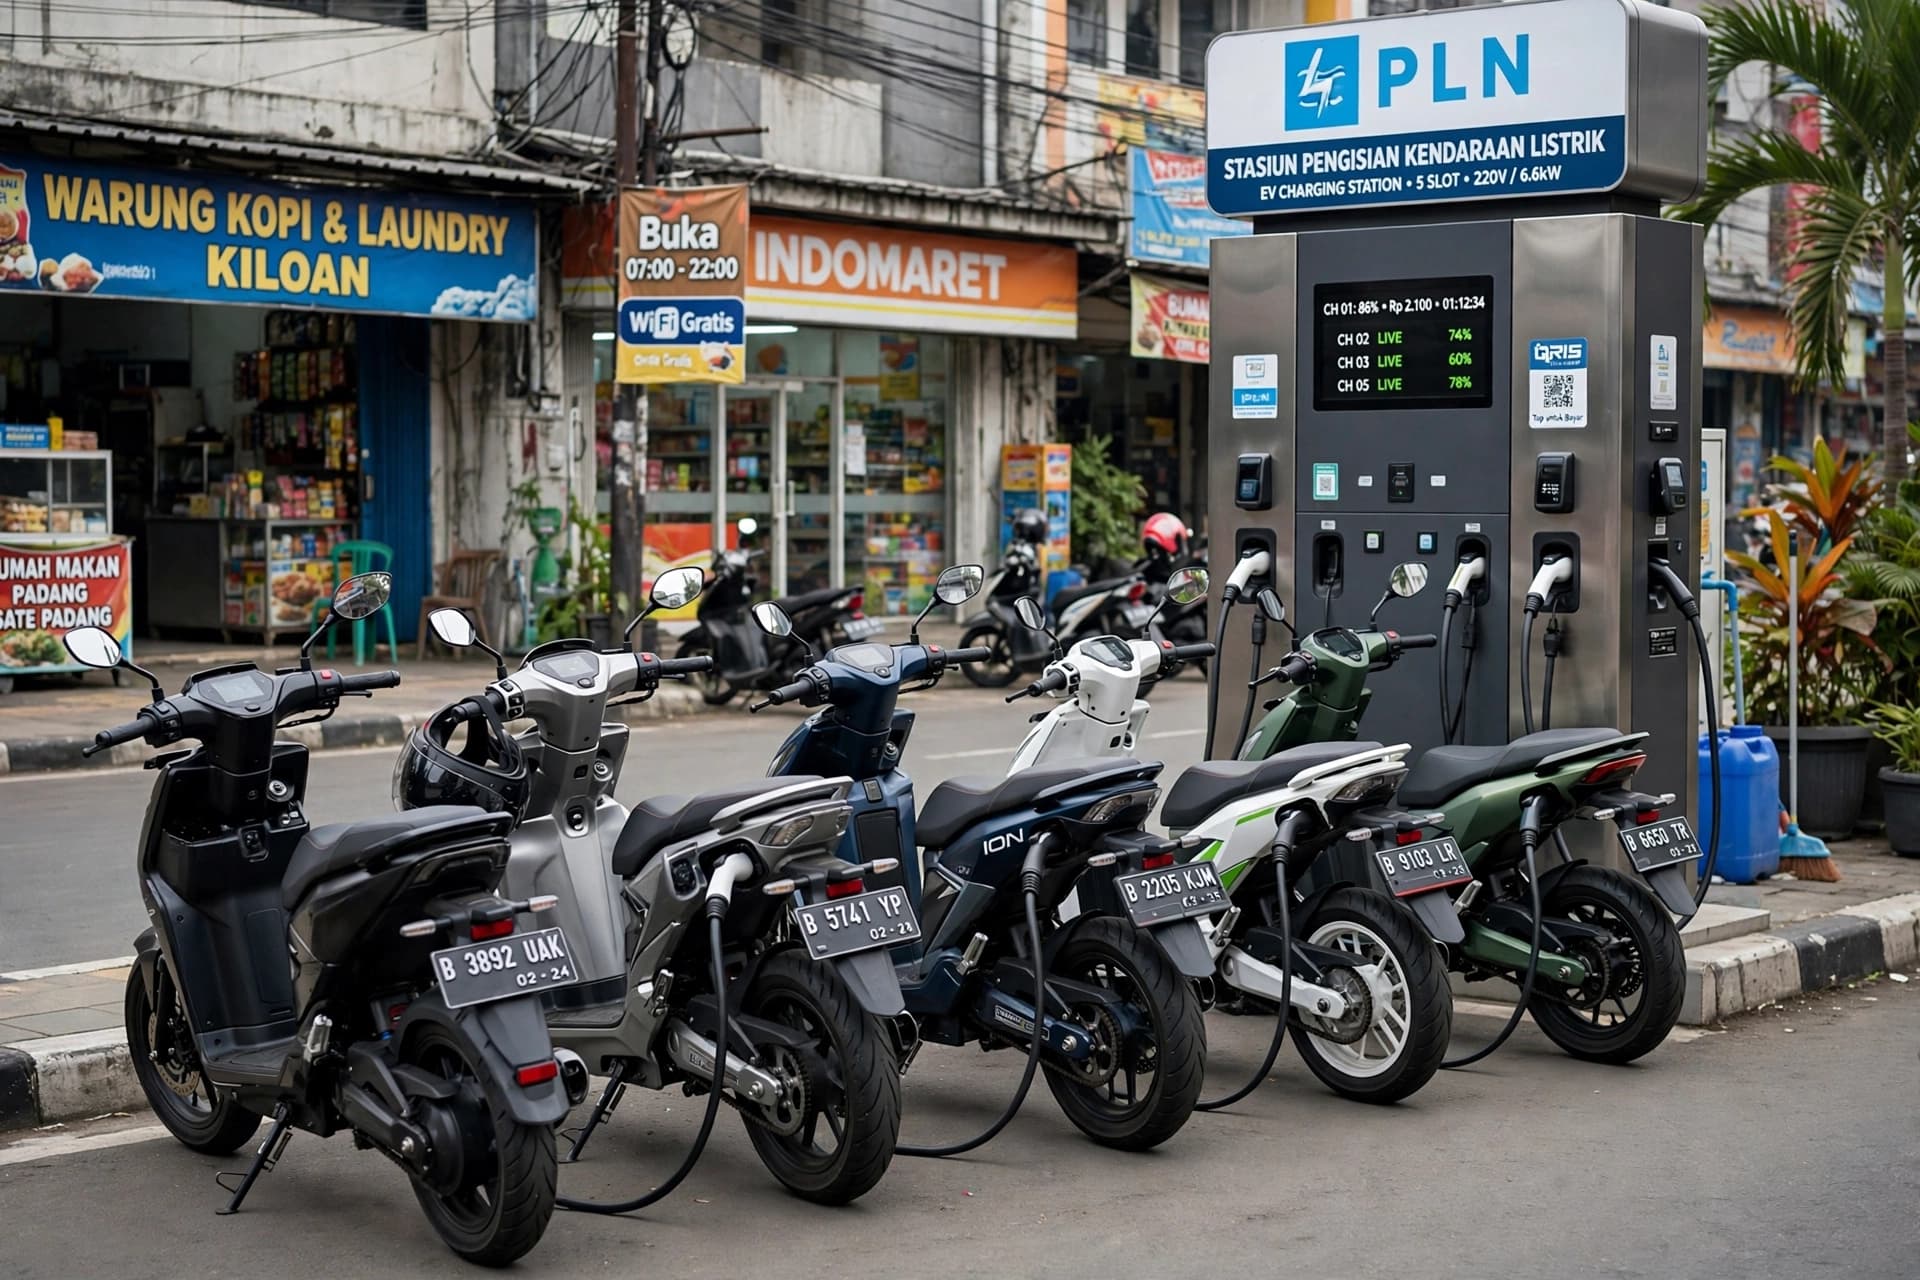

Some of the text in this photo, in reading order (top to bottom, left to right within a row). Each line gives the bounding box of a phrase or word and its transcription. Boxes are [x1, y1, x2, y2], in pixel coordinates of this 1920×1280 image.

[1378, 34, 1529, 108] PLN
[1224, 153, 1298, 180] STASIUN
[1302, 145, 1399, 175] PENGISIAN
[1404, 133, 1525, 168] KENDARAAN
[1531, 128, 1606, 157] LISTRIK
[1260, 186, 1277, 200] EV
[1279, 181, 1346, 198] CHARGING
[1348, 177, 1402, 194] STATION
[1416, 175, 1424, 190] 5
[1427, 172, 1460, 188] SLOT
[1473, 168, 1507, 185] 220V
[1520, 165, 1562, 182] 6.6kW
[43, 173, 510, 256] WARUNG KOPI & LAUNDRY
[639, 214, 719, 250] Buka
[207, 244, 369, 297] KILOAN
[626, 257, 675, 280] 07:00
[688, 257, 738, 280] 22:00
[755, 231, 1007, 300] INDOMARET
[1323, 303, 1338, 316] CH
[1340, 302, 1357, 315] 01:
[1357, 300, 1379, 314] 86%
[1389, 300, 1403, 315] Rp
[1404, 298, 1433, 312] 2.100
[1442, 296, 1485, 310] 01:12:34
[681, 311, 735, 333] Gratis
[1337, 328, 1472, 346] CH 02 LIVE 74%
[1337, 352, 1472, 369] CH 03 LIVE 60%
[1534, 343, 1582, 363] QRIS
[1337, 376, 1472, 392] CH 05 LIVE 78%
[56, 555, 119, 579] MAKAN
[12, 582, 88, 605] PADANG
[41, 605, 112, 629] PADANG
[983, 827, 1024, 855] ION
[1626, 822, 1690, 851] B 6650 TR
[1382, 843, 1457, 875] B 9103 LR
[1125, 867, 1217, 903] B 2205 KJM
[802, 894, 901, 934] B 5741 YP
[870, 927, 887, 940] 02
[439, 934, 565, 981] B 3892 UAK
[516, 971, 537, 986] 02
